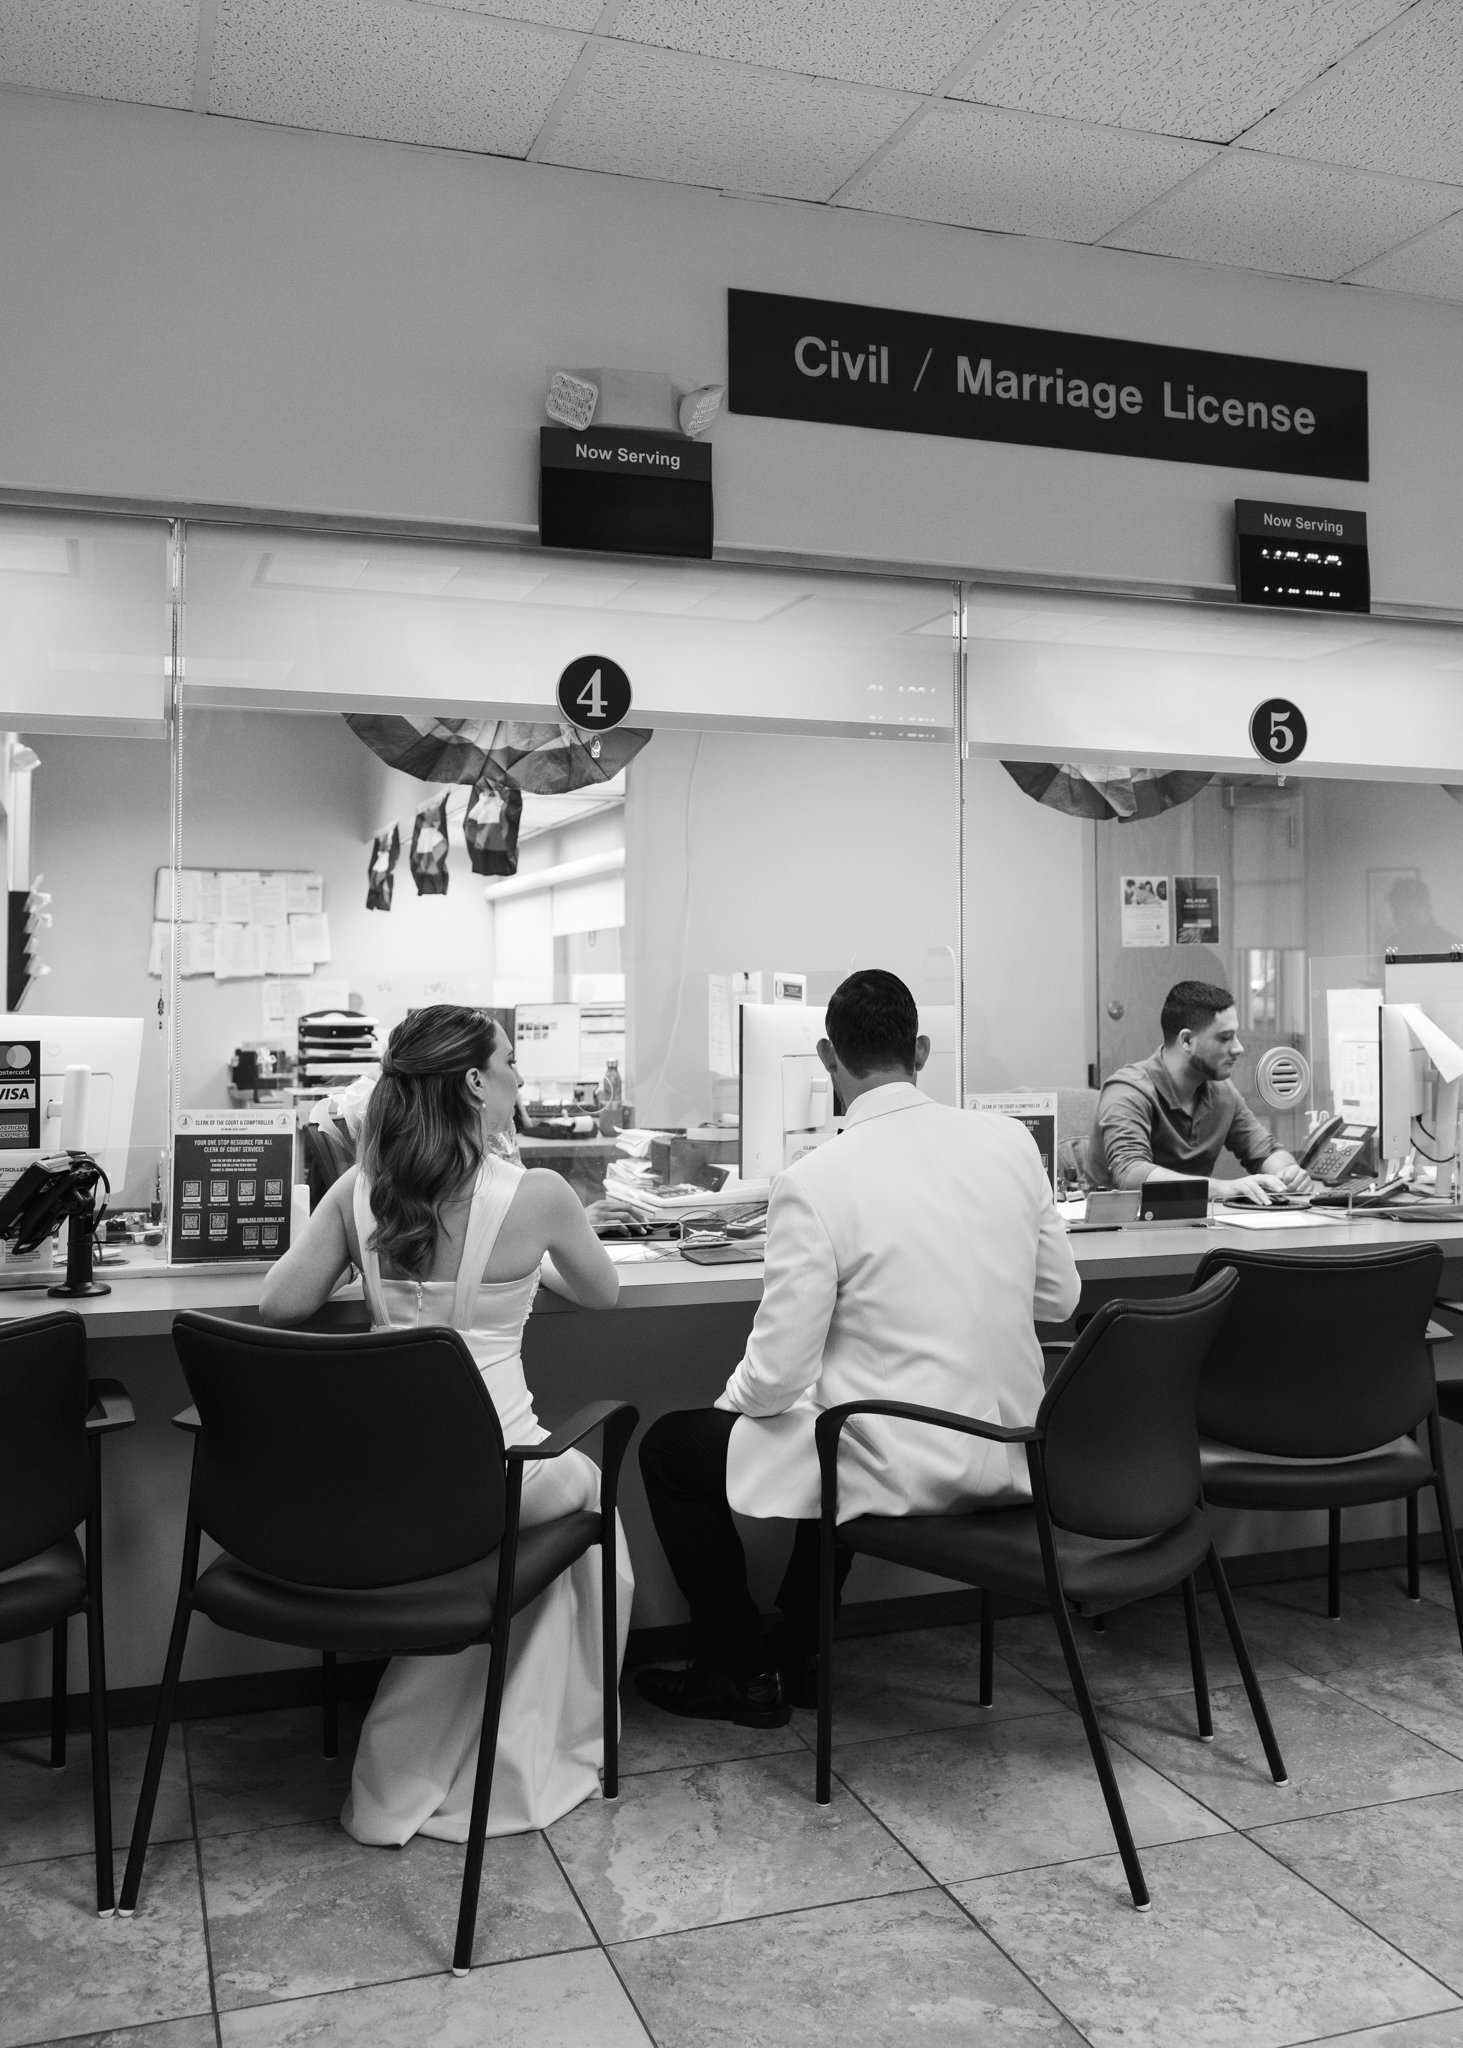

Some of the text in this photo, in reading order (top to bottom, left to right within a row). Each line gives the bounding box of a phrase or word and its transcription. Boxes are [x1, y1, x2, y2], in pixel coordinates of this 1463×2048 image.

[794, 335, 1317, 435] Civil / Marriage License
[575, 443, 681, 470] Now Serving
[1263, 512, 1344, 537] Now Serving
[576, 668, 609, 718] 4
[1269, 711, 1294, 753] 5
